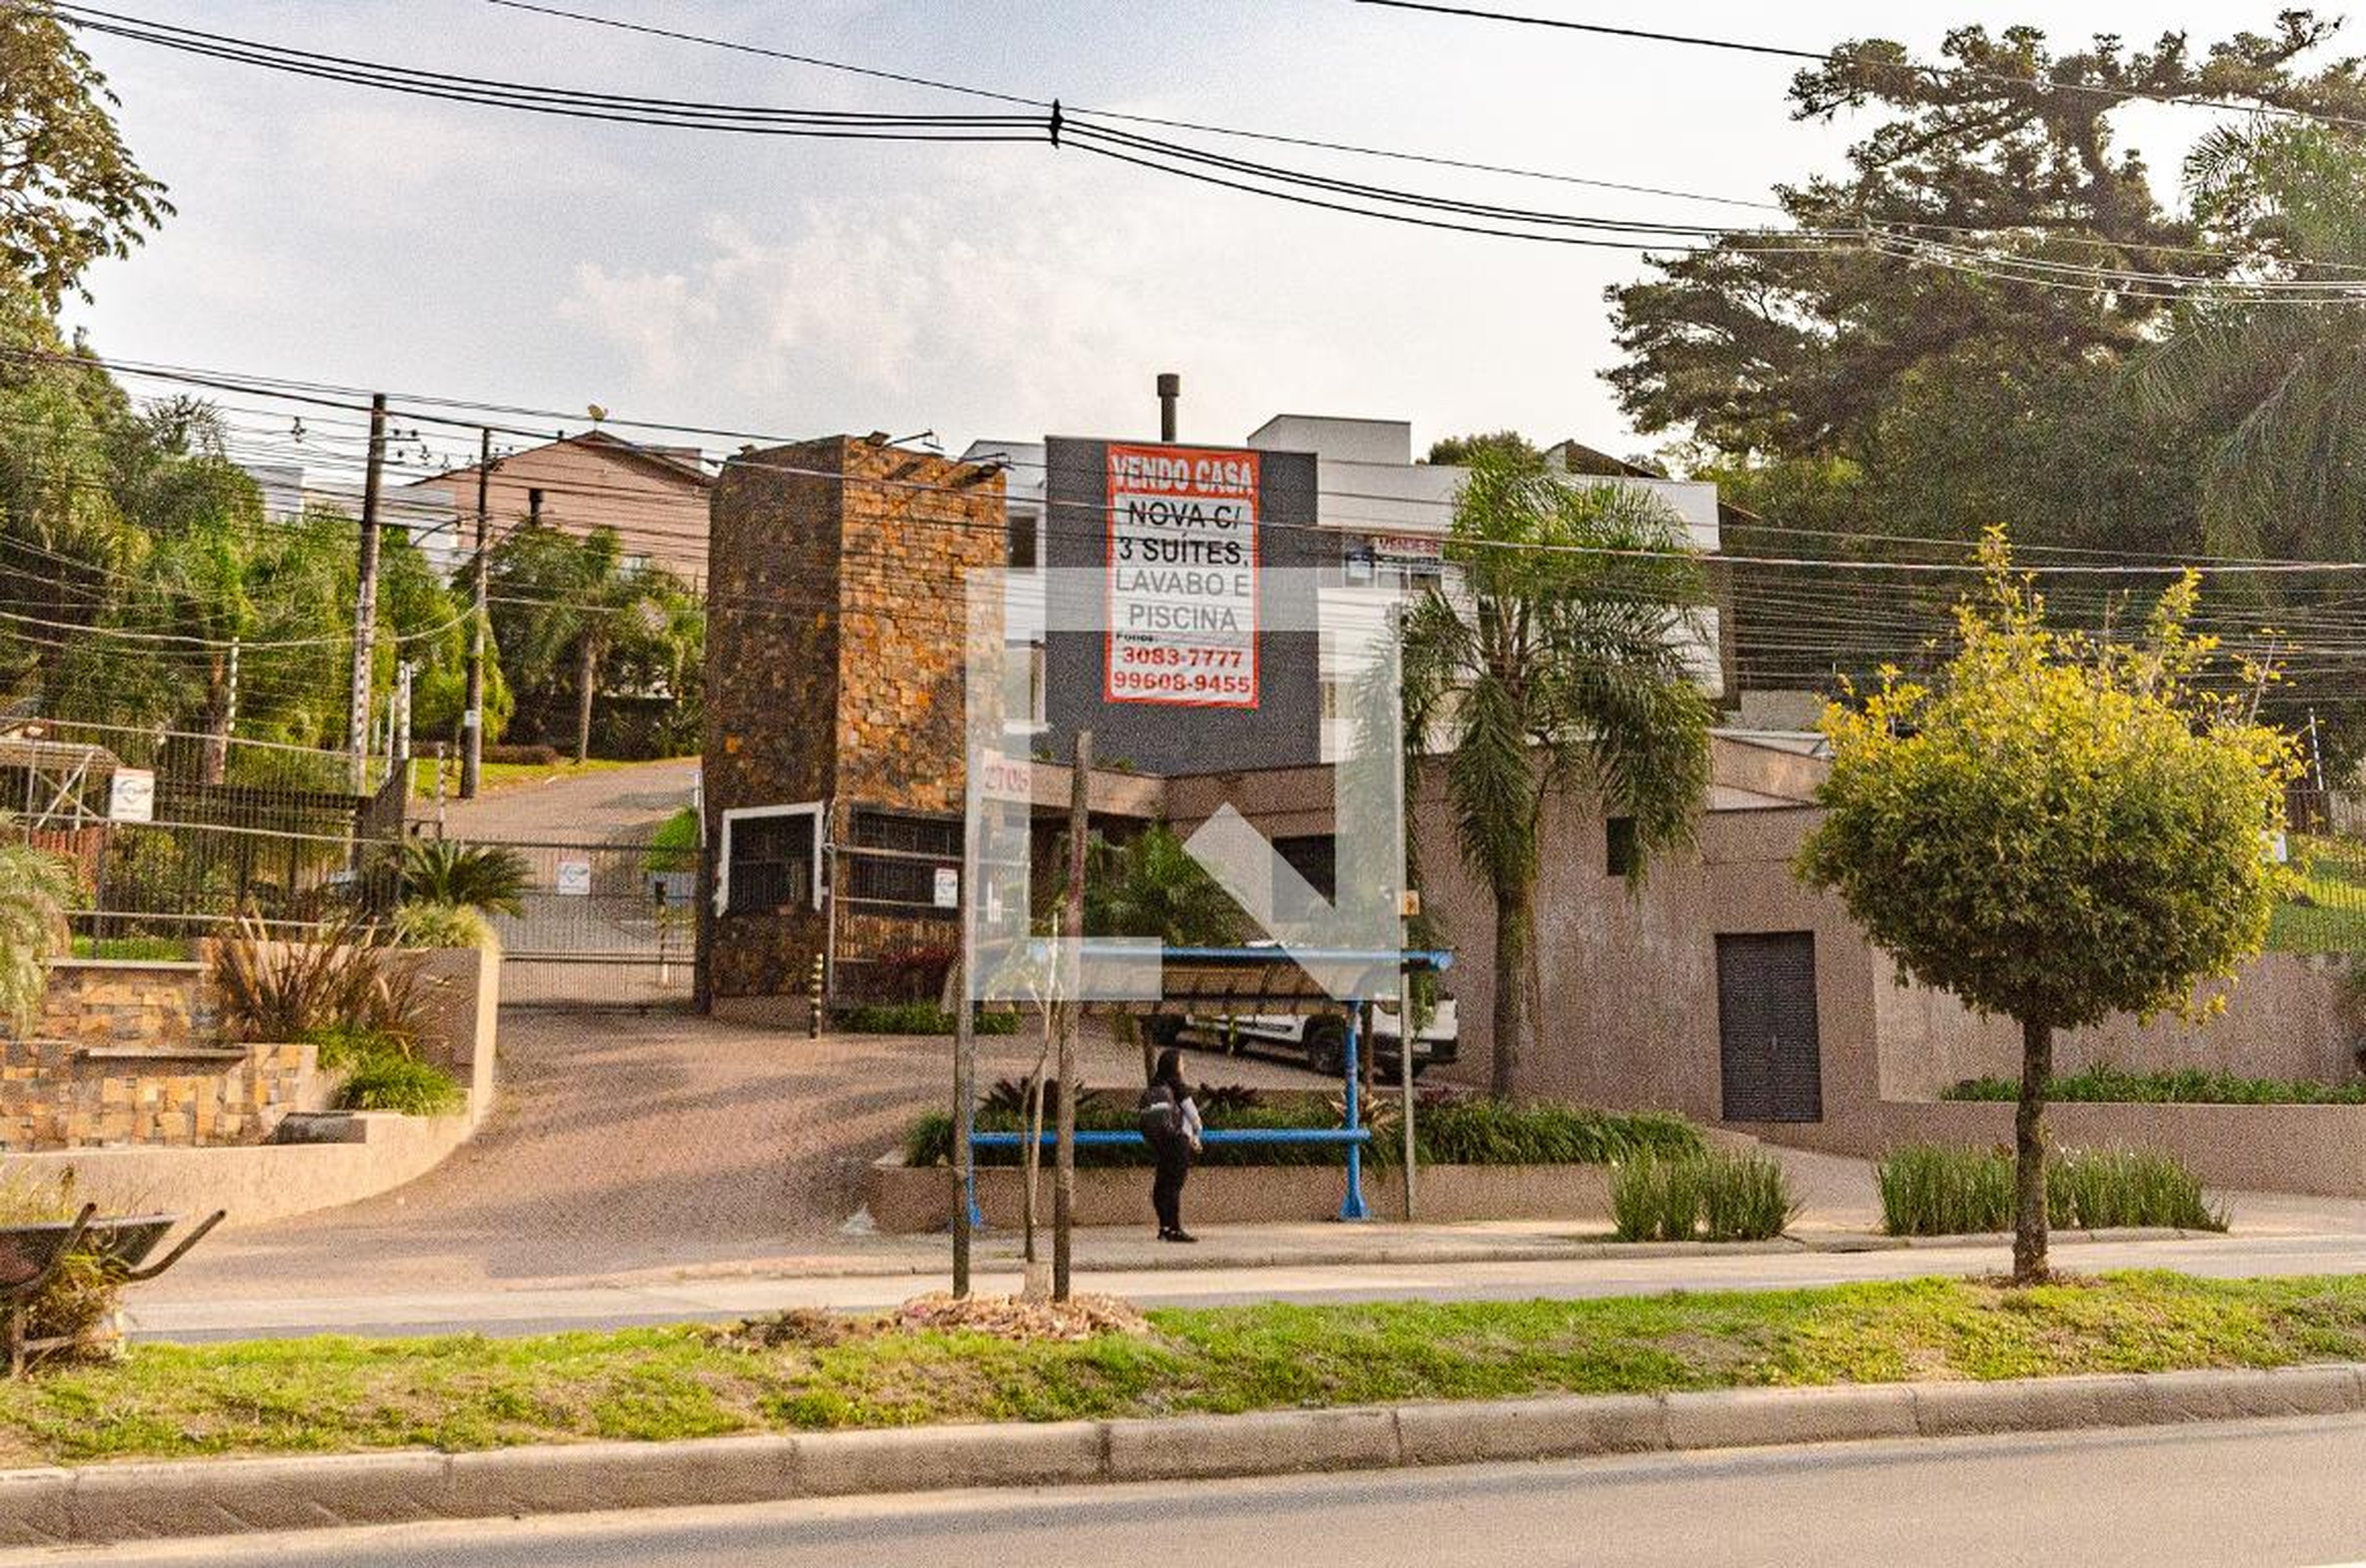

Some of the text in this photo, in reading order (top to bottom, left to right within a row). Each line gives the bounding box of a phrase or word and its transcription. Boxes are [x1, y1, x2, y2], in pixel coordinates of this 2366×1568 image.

[1112, 455, 1254, 494] VENDO CASA
[1128, 500, 1242, 530] NOVA C/
[1120, 532, 1249, 567] 3 SUÍTES,
[1116, 569, 1250, 597] LAVABO E
[1129, 604, 1238, 632] PISCINA
[1123, 646, 1243, 668] 3083-7777
[1114, 671, 1250, 694] 99608-9455
